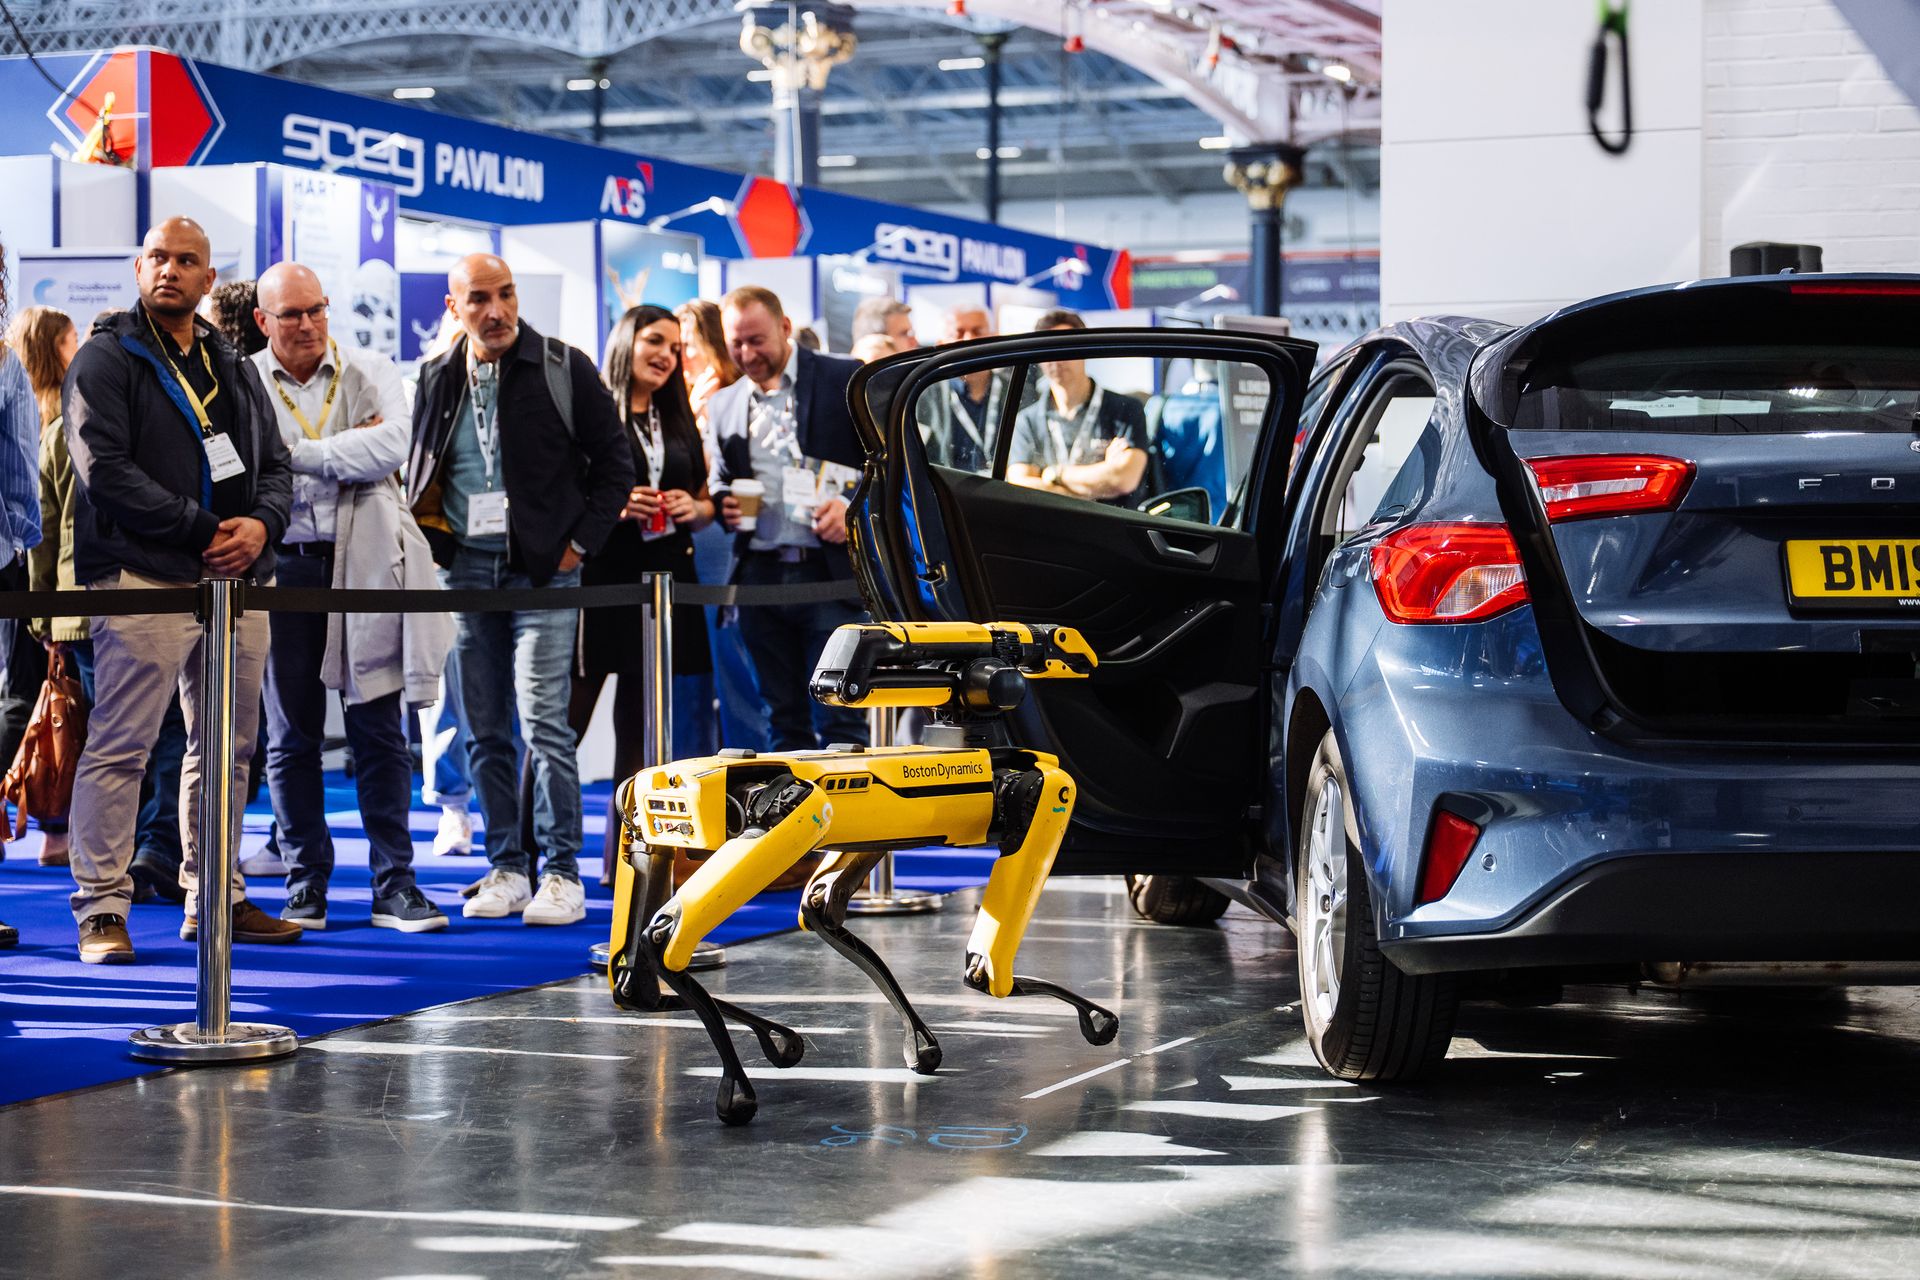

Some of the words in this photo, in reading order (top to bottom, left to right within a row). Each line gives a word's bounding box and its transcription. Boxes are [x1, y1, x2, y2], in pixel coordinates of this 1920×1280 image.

[435, 142, 545, 203] PAVILION
[599, 174, 646, 219] ADS
[902, 760, 984, 780] BostonDynamics
